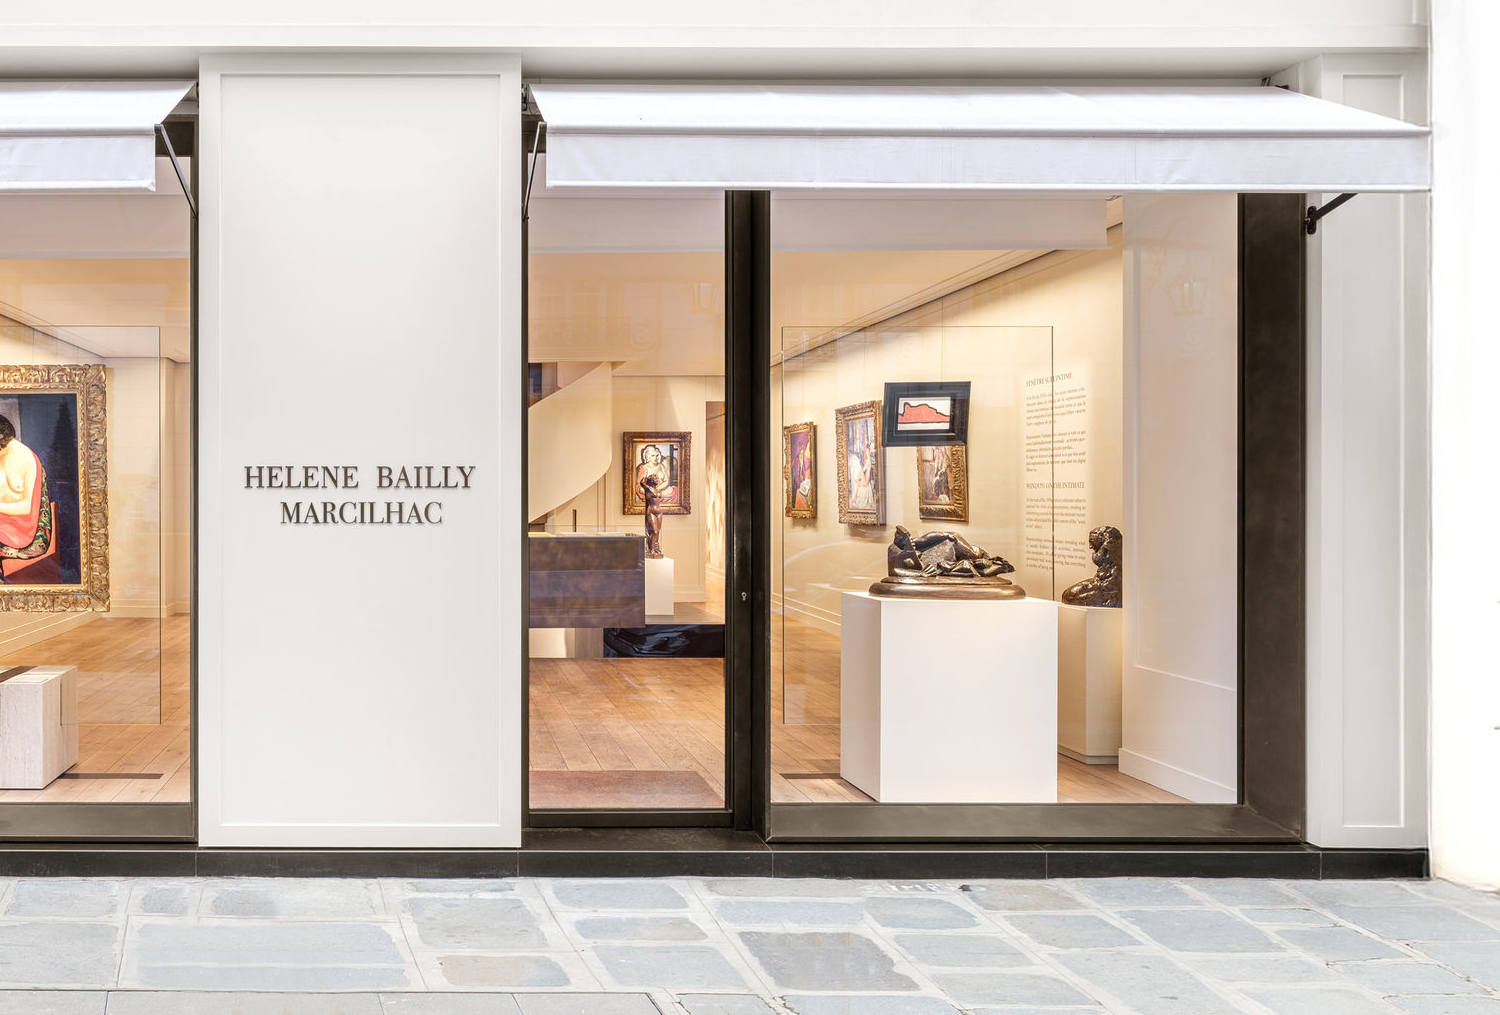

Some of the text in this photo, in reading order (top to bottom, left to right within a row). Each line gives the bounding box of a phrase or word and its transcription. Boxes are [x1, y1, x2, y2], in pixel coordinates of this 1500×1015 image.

[244, 465, 476, 489] HELENE BAILLY
[280, 501, 443, 525] MARCILHAC
